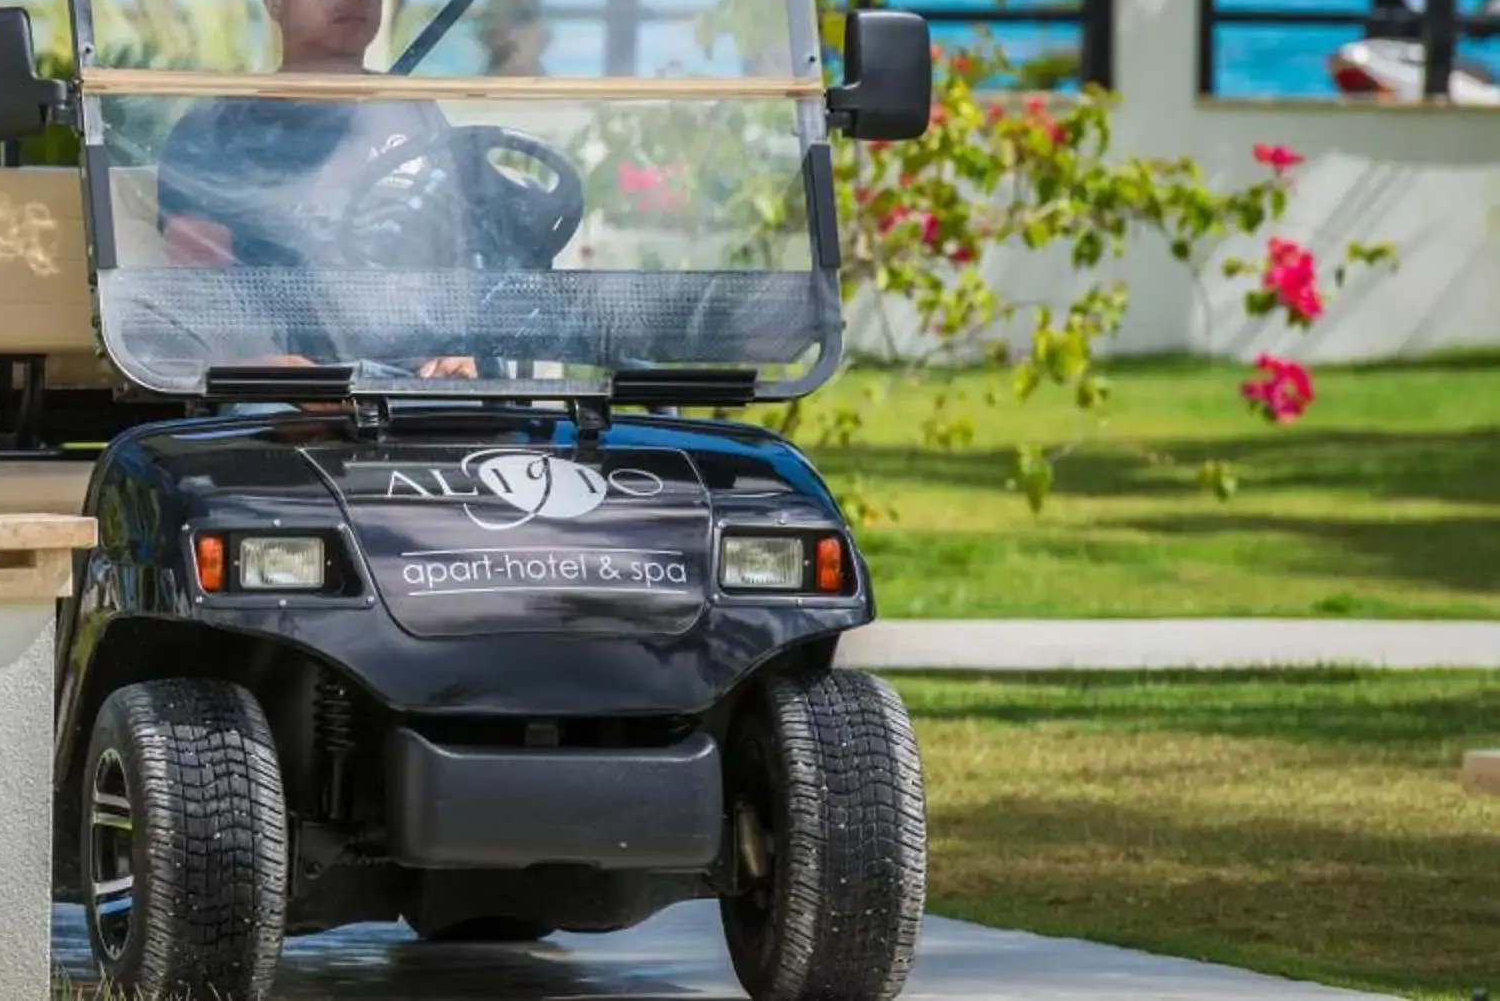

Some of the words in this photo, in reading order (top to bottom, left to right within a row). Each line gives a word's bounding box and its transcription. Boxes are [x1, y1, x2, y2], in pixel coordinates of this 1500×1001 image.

[403, 553, 587, 589] apart-hotel
[599, 556, 621, 579] &
[630, 561, 687, 587] spa
